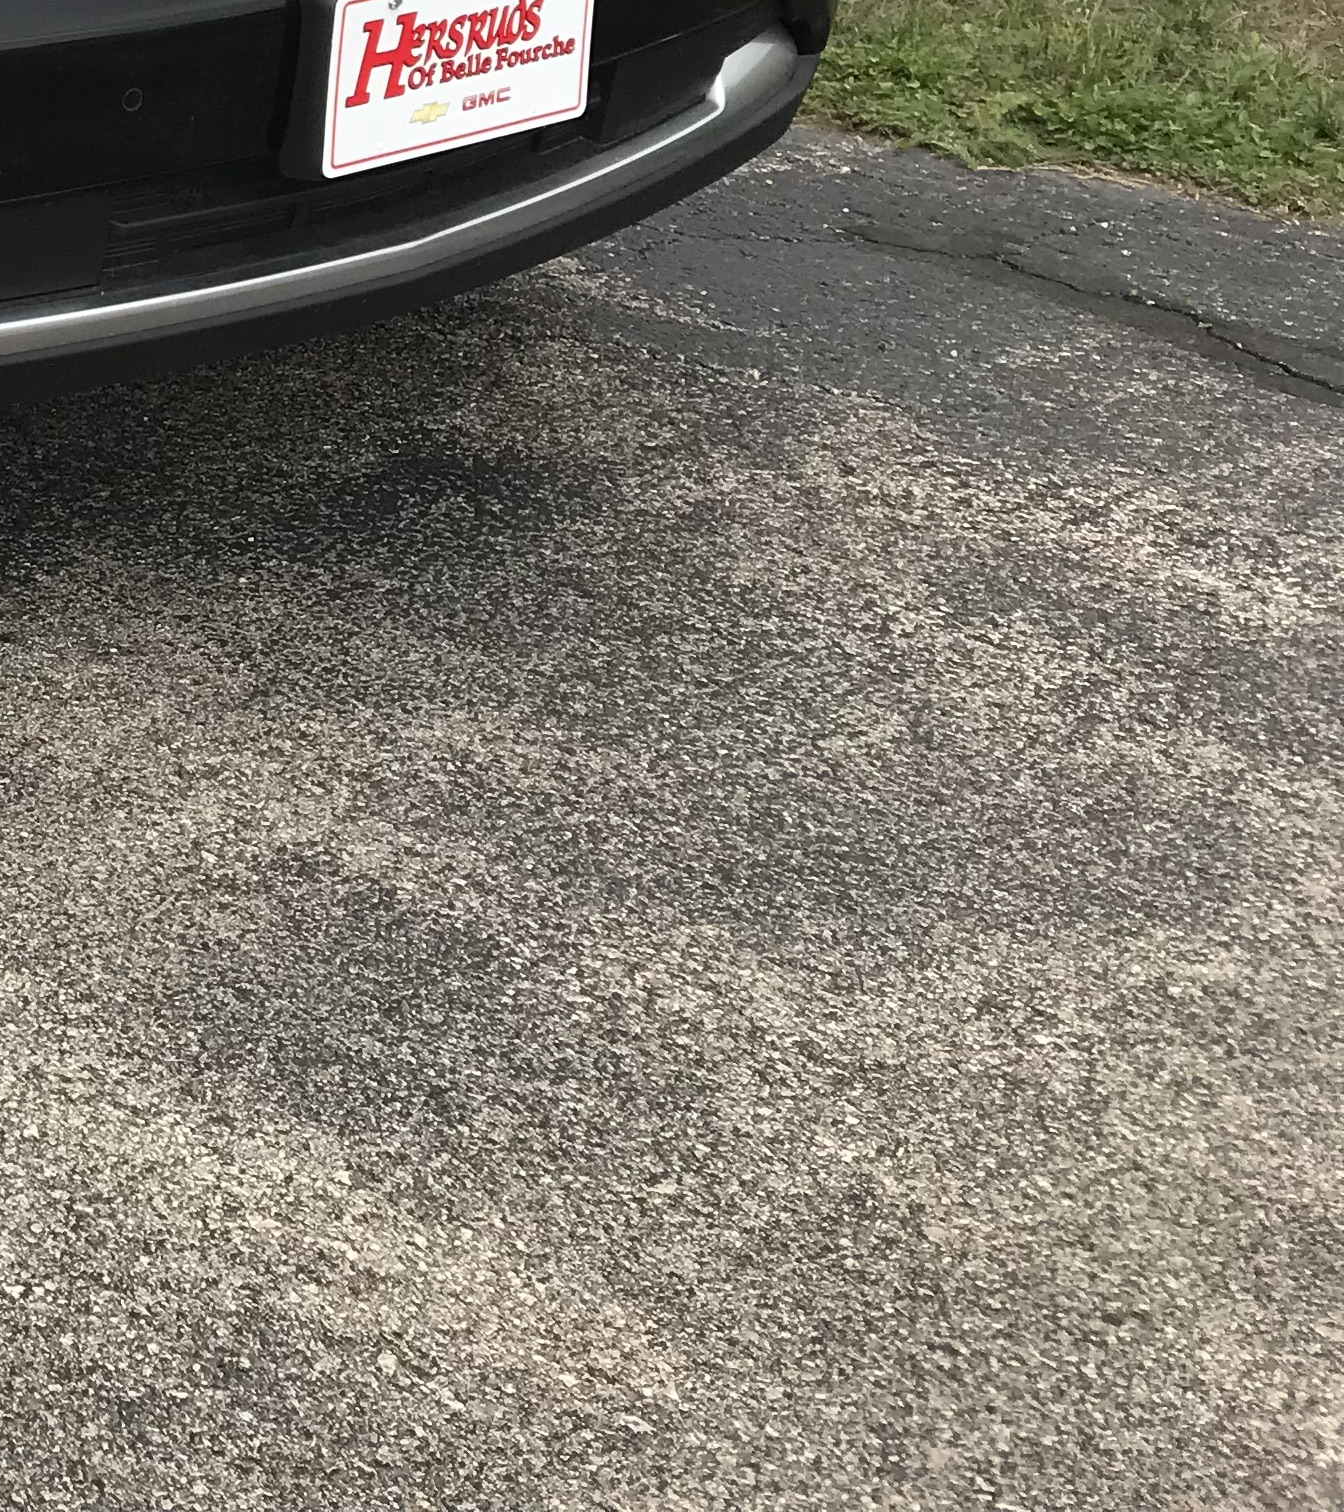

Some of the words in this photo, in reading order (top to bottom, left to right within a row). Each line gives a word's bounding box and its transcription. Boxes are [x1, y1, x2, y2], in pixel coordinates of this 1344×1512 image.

[408, 63, 438, 90] Of
[439, 50, 492, 84] Belle
[494, 35, 576, 72] Fourche
[462, 87, 511, 111] GMC
